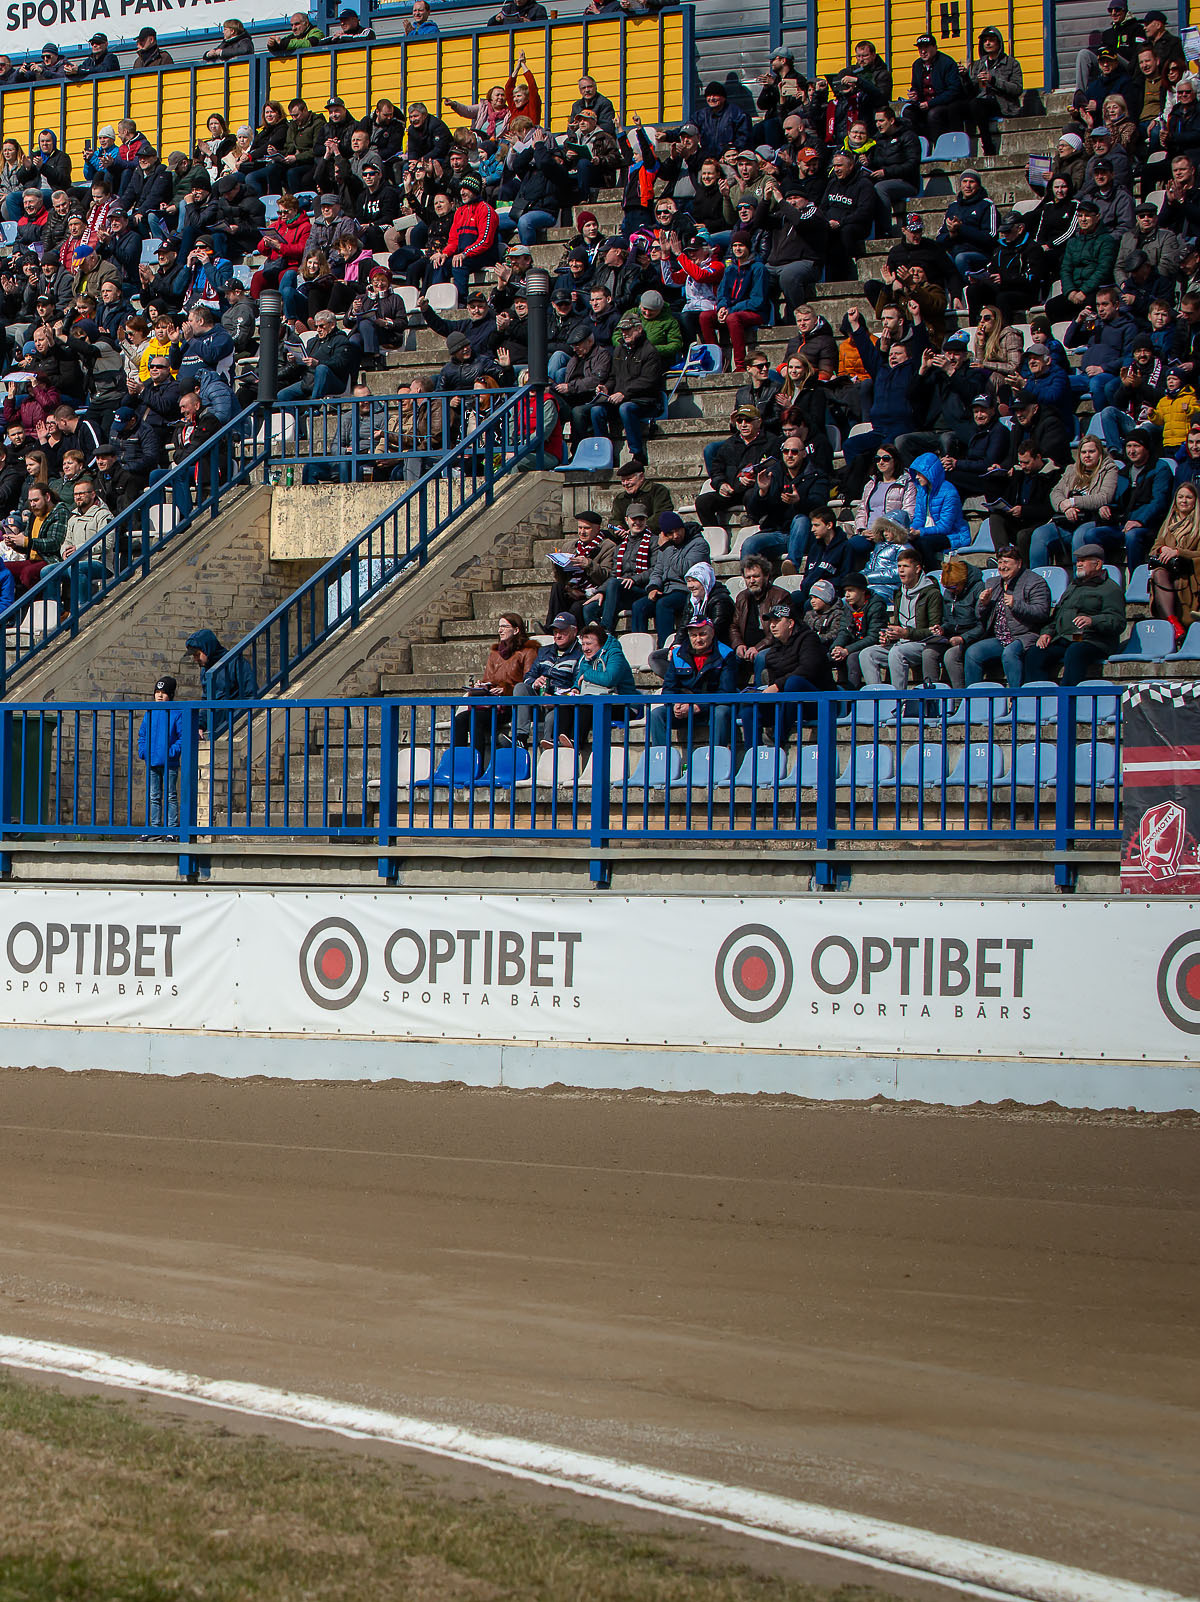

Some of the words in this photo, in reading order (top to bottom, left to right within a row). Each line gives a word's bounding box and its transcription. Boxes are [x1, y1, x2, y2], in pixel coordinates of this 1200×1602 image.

[7, 0, 110, 31] SPORTA
[940, 1, 960, 39] H
[1003, 192, 1016, 204] 13
[402, 730, 409, 743] 2
[760, 751, 769, 761] 39
[976, 749, 986, 759] 35
[1143, 808, 1176, 848] LOKOMOTIV
[7, 921, 181, 977] OPTIBET
[383, 928, 582, 988] OPTIBET
[811, 935, 1034, 998] OPTIBET
[6, 979, 100, 995] SPORTA
[118, 979, 179, 997] BĀRS
[382, 991, 490, 1006] SPORTA
[511, 990, 581, 1009] BĀRS
[811, 1001, 931, 1018] SPORTA
[954, 1001, 1031, 1020] BĀRS
